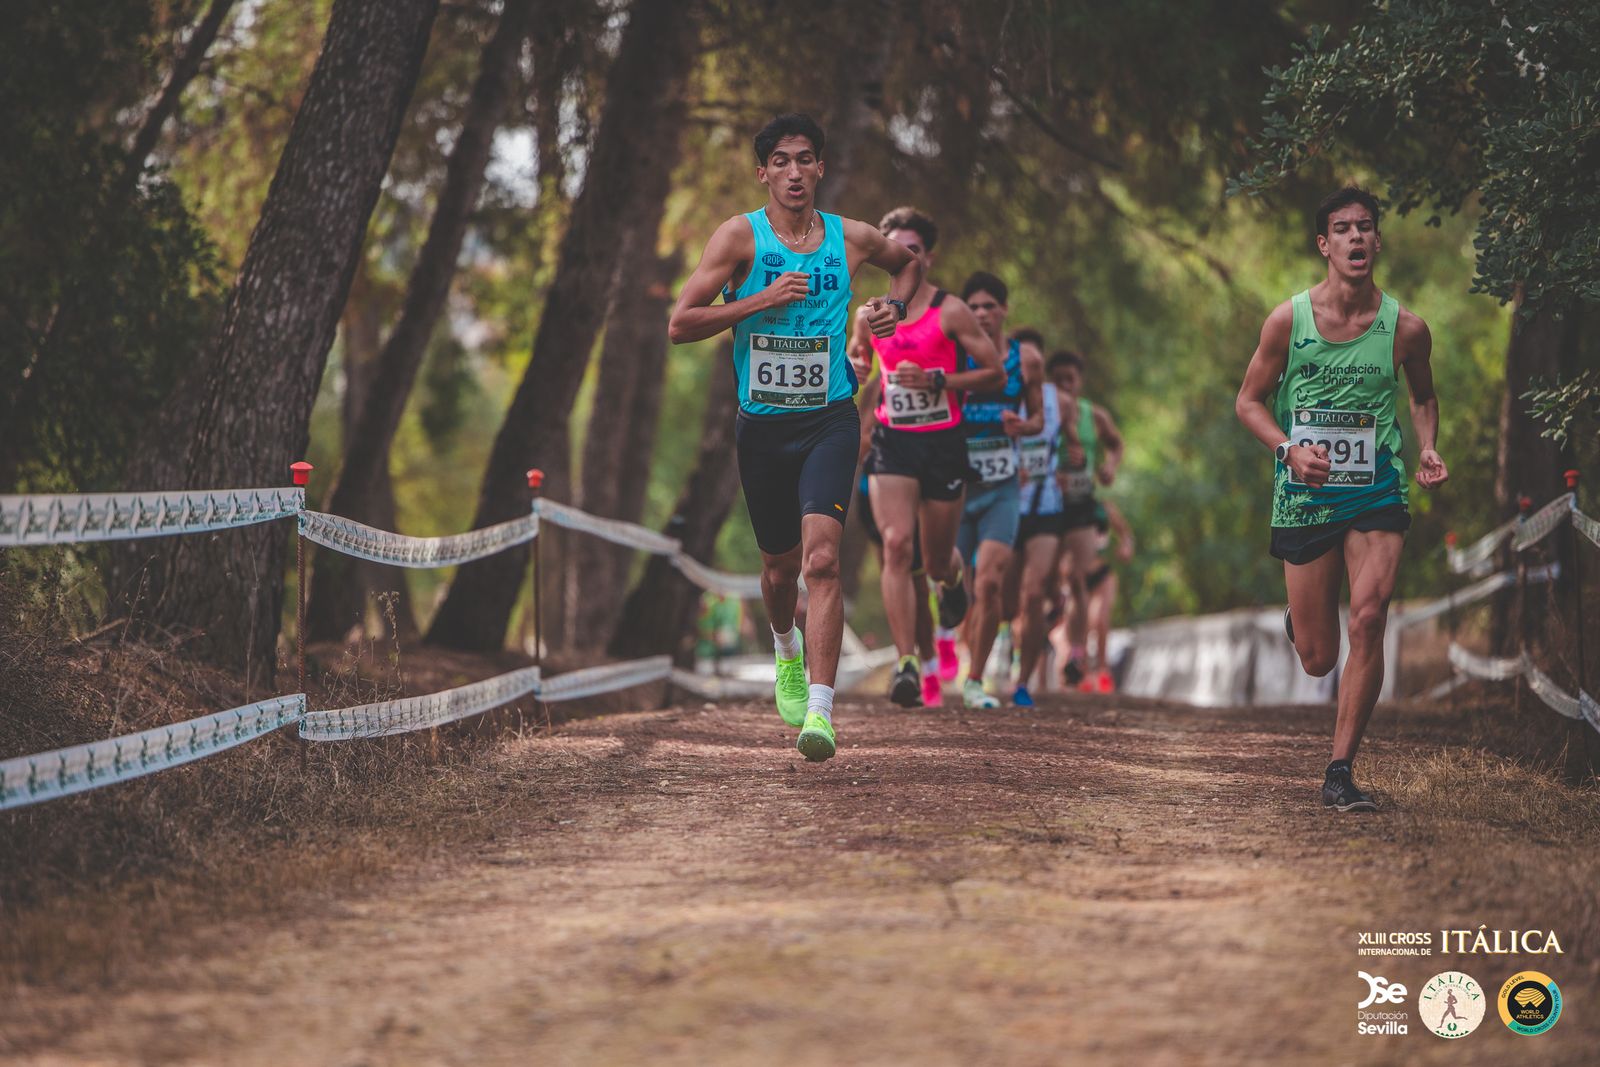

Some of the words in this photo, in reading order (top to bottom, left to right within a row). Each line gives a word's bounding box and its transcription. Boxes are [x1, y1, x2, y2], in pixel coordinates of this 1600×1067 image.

[763, 267, 839, 297] nja
[773, 338, 811, 349] ITÁLICA
[757, 362, 824, 388] 6138
[1323, 363, 1381, 375] Fundación
[1315, 412, 1355, 423] ITÁLICA
